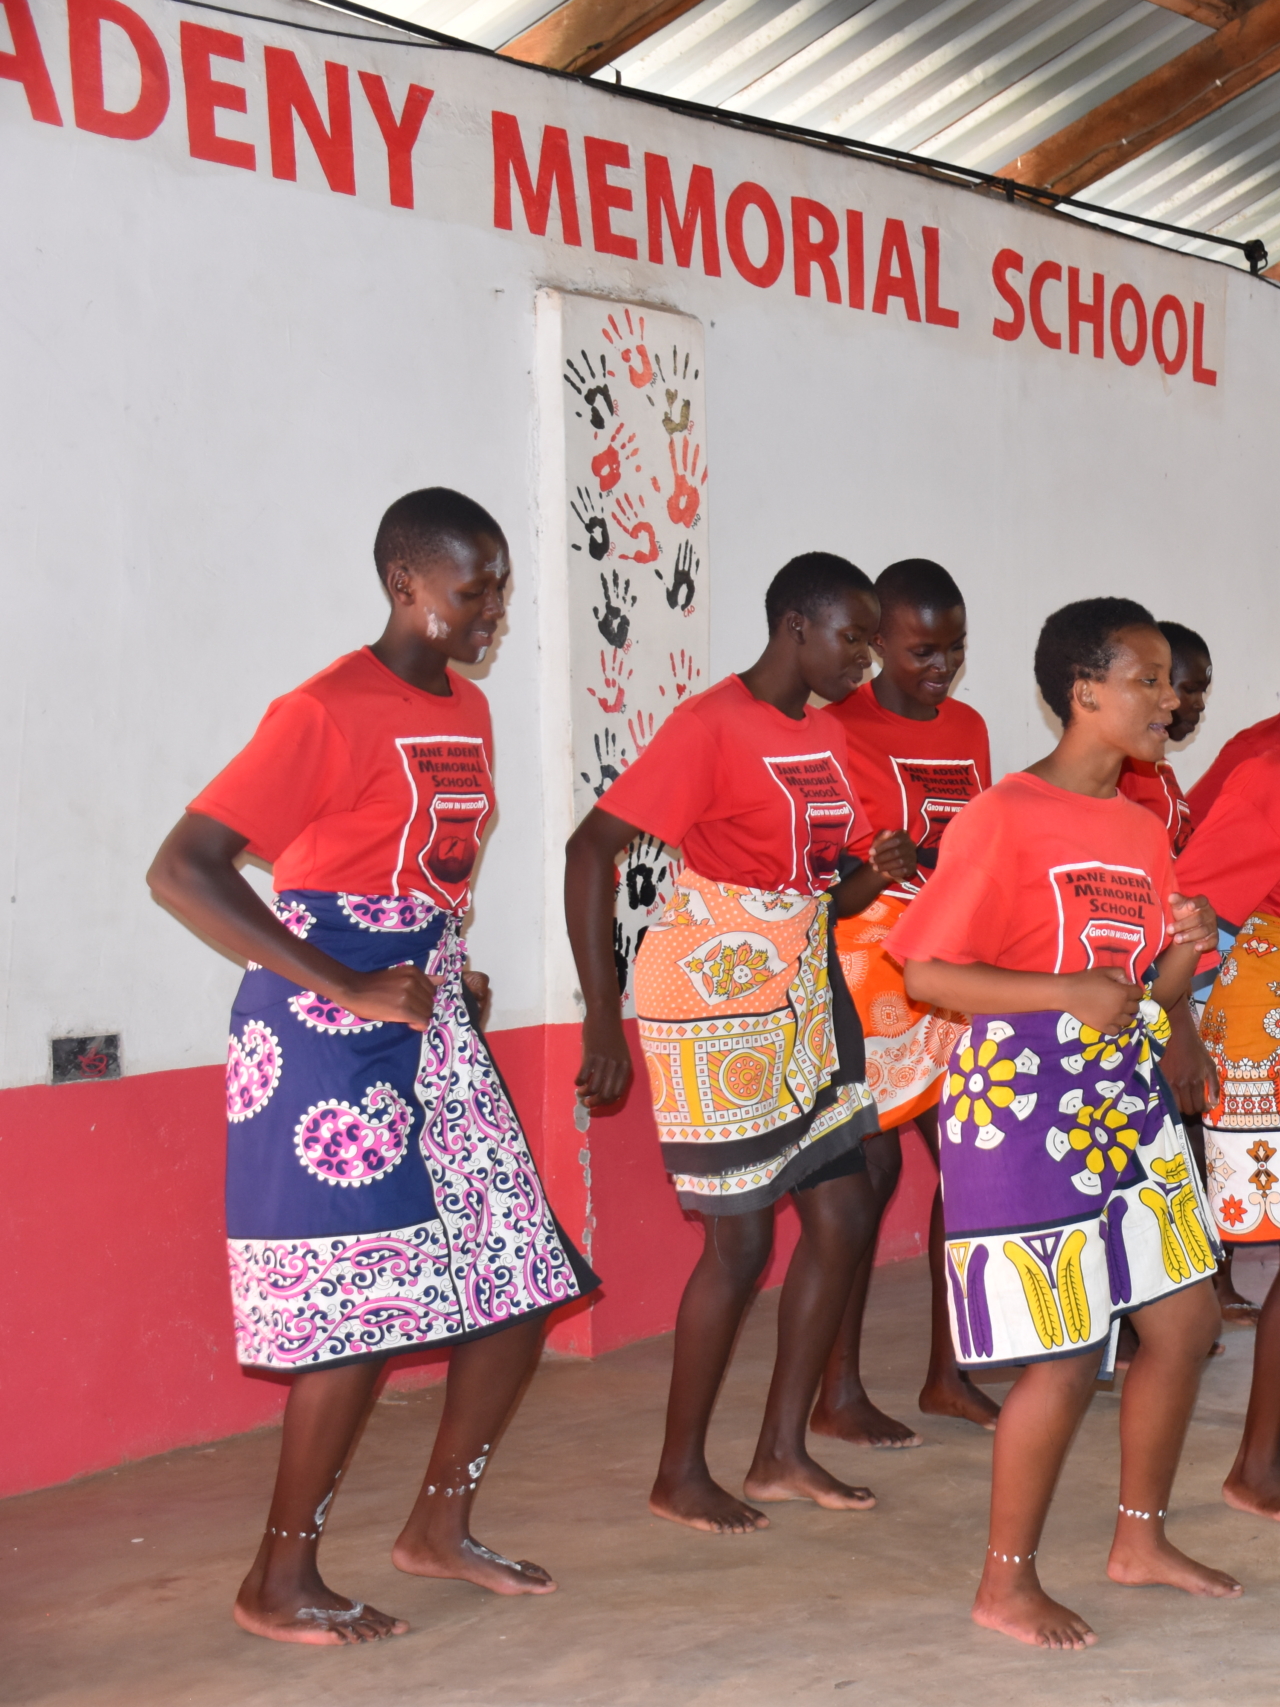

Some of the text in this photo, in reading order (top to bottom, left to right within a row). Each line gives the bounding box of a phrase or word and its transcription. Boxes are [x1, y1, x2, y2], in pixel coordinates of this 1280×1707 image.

[491, 110, 959, 329] MEMORIAL
[991, 247, 1217, 386] SCHOOL
[411, 745, 480, 759] JANE ADENY
[418, 760, 484, 773] MEMORIAL
[776, 760, 831, 775] JANE ADENY
[902, 764, 970, 775] JANE ADENY
[432, 774, 481, 788] SCHOOL
[785, 773, 838, 786] MEMORIAL
[910, 774, 973, 786] MEMORIAL
[800, 786, 840, 798] SCHOOL
[923, 784, 970, 796] SCHOOL
[435, 800, 484, 809] GROW IN WISDOM
[927, 803, 944, 811] GROW
[810, 808, 824, 817] GROW
[829, 806, 850, 815] WISDOM
[1065, 872, 1152, 890] JANE ADENY
[1074, 884, 1155, 906] MEMORIAL
[1090, 898, 1145, 919] SCHOOL
[1115, 930, 1140, 942] WISDOM
